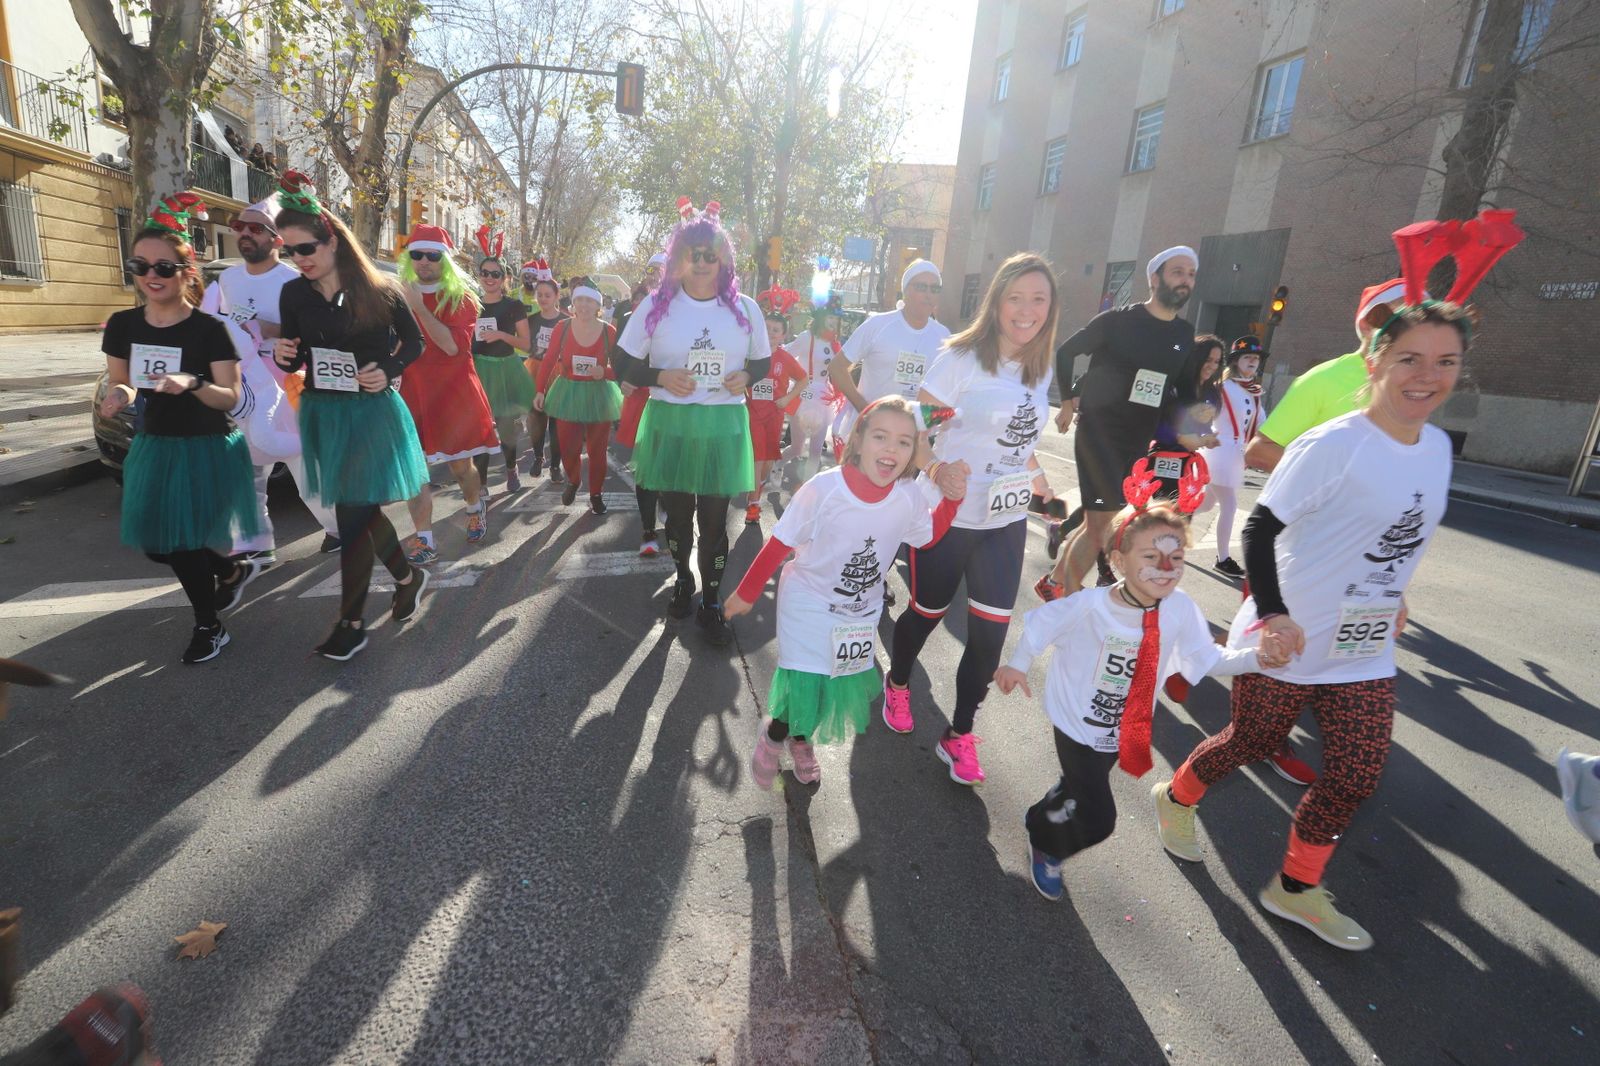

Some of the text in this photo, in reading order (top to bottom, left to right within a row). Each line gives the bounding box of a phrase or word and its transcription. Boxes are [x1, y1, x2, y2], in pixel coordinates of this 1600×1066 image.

[143, 359, 167, 375] 18
[317, 361, 356, 378] 259
[692, 362, 721, 376] 413
[896, 360, 924, 376] 384
[753, 384, 773, 394] 459
[1135, 379, 1162, 396] 655
[1157, 460, 1180, 472] 212
[991, 489, 1031, 511] 403
[1336, 621, 1389, 642] 592
[837, 641, 872, 661] 402
[1105, 653, 1137, 678] 59
